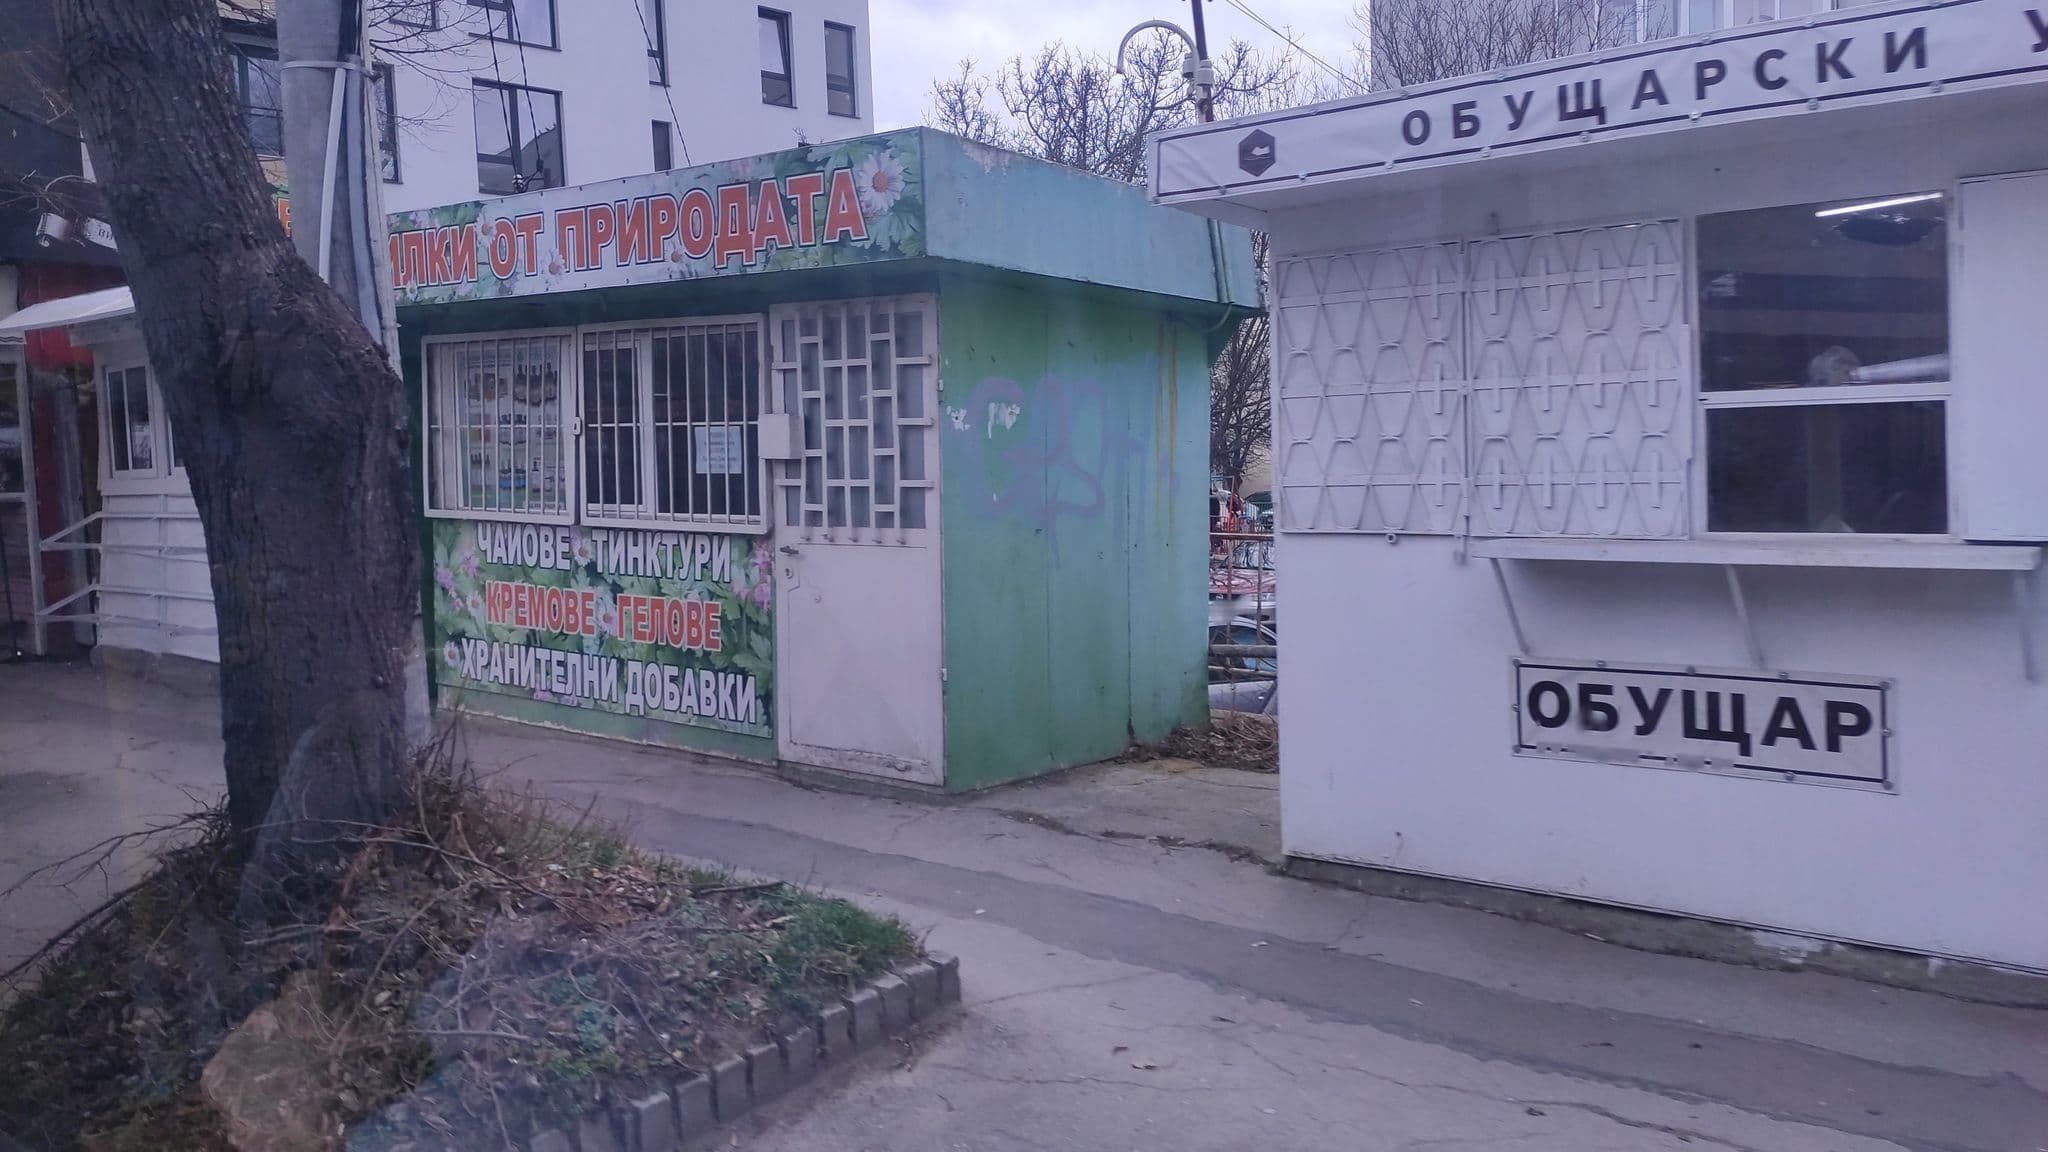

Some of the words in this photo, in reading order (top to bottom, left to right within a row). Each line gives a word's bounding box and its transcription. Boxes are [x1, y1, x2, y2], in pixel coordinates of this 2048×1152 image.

[1402, 26, 1928, 147] ОБУЩАРСКИ
[489, 211, 545, 280] ОТ
[555, 166, 870, 271] ПРИРОДАТА
[591, 528, 731, 583] ТИНКТУРИ
[485, 580, 597, 637] КРЕМОВЕ
[616, 593, 722, 652] ГЕЛОВЕ
[460, 637, 618, 704] ХРАНИТЕЛНИ
[625, 660, 757, 724] ДОБАВКИ
[1527, 680, 1873, 757] ОБУЩАР
